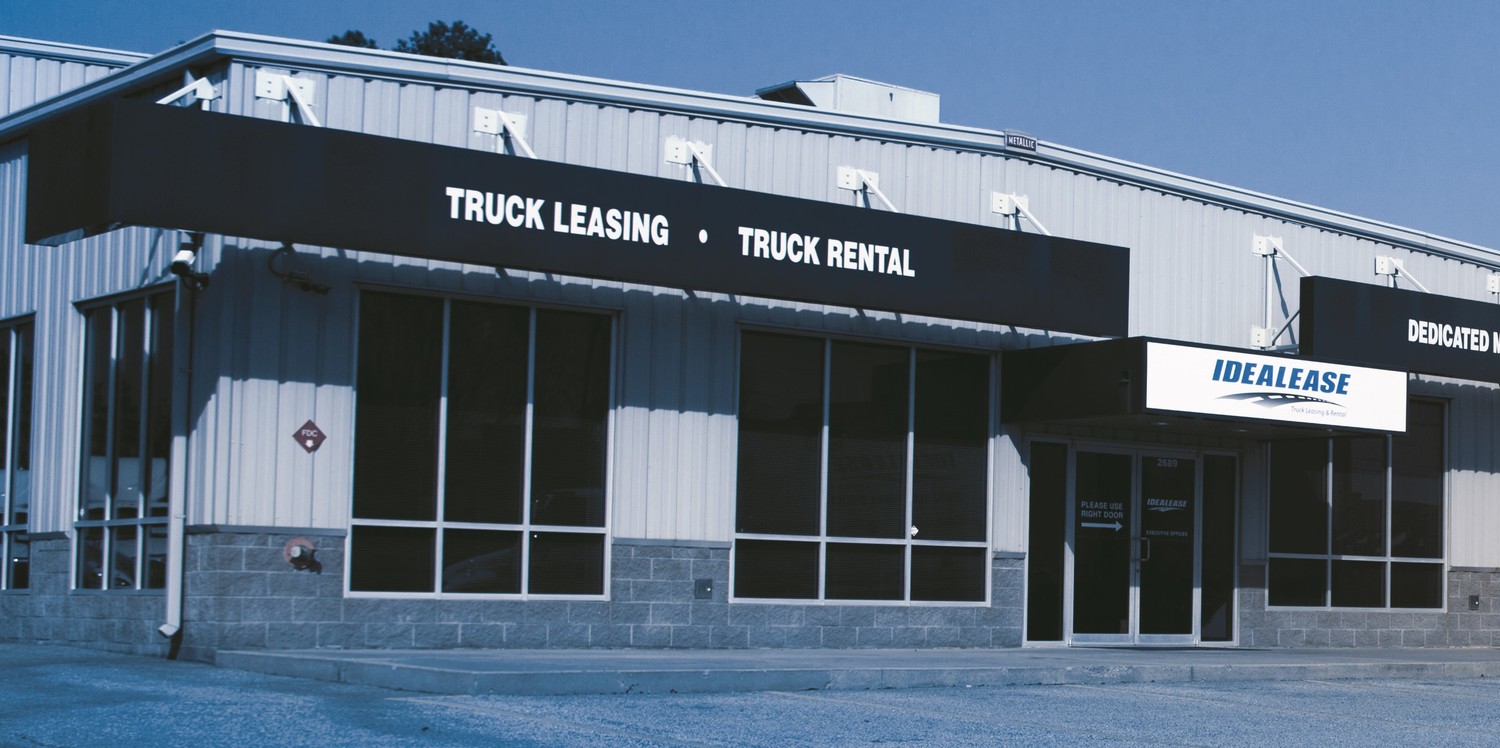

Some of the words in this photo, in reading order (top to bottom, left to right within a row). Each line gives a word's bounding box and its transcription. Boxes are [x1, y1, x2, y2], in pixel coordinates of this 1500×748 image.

[1008, 136, 1035, 149] METALLIC
[445, 186, 546, 231] TRUCK
[553, 201, 669, 246] LEASING
[738, 226, 821, 265] TRUCK
[827, 238, 916, 277] RENTAL
[1408, 319, 1490, 352] DEDICATED
[1212, 359, 1351, 395] IDEALEASE
[1291, 405, 1304, 413] Truck
[1305, 407, 1325, 417] Leasing
[1330, 410, 1347, 418] Rental
[301, 429, 319, 437] FDC
[1157, 458, 1178, 468] 2689
[1081, 501, 1108, 509] PLEASE
[1109, 502, 1123, 510] USE
[1147, 498, 1187, 508] IDEALEASE
[1081, 510, 1102, 518] RIGHT
[1103, 511, 1124, 519] DOOR
